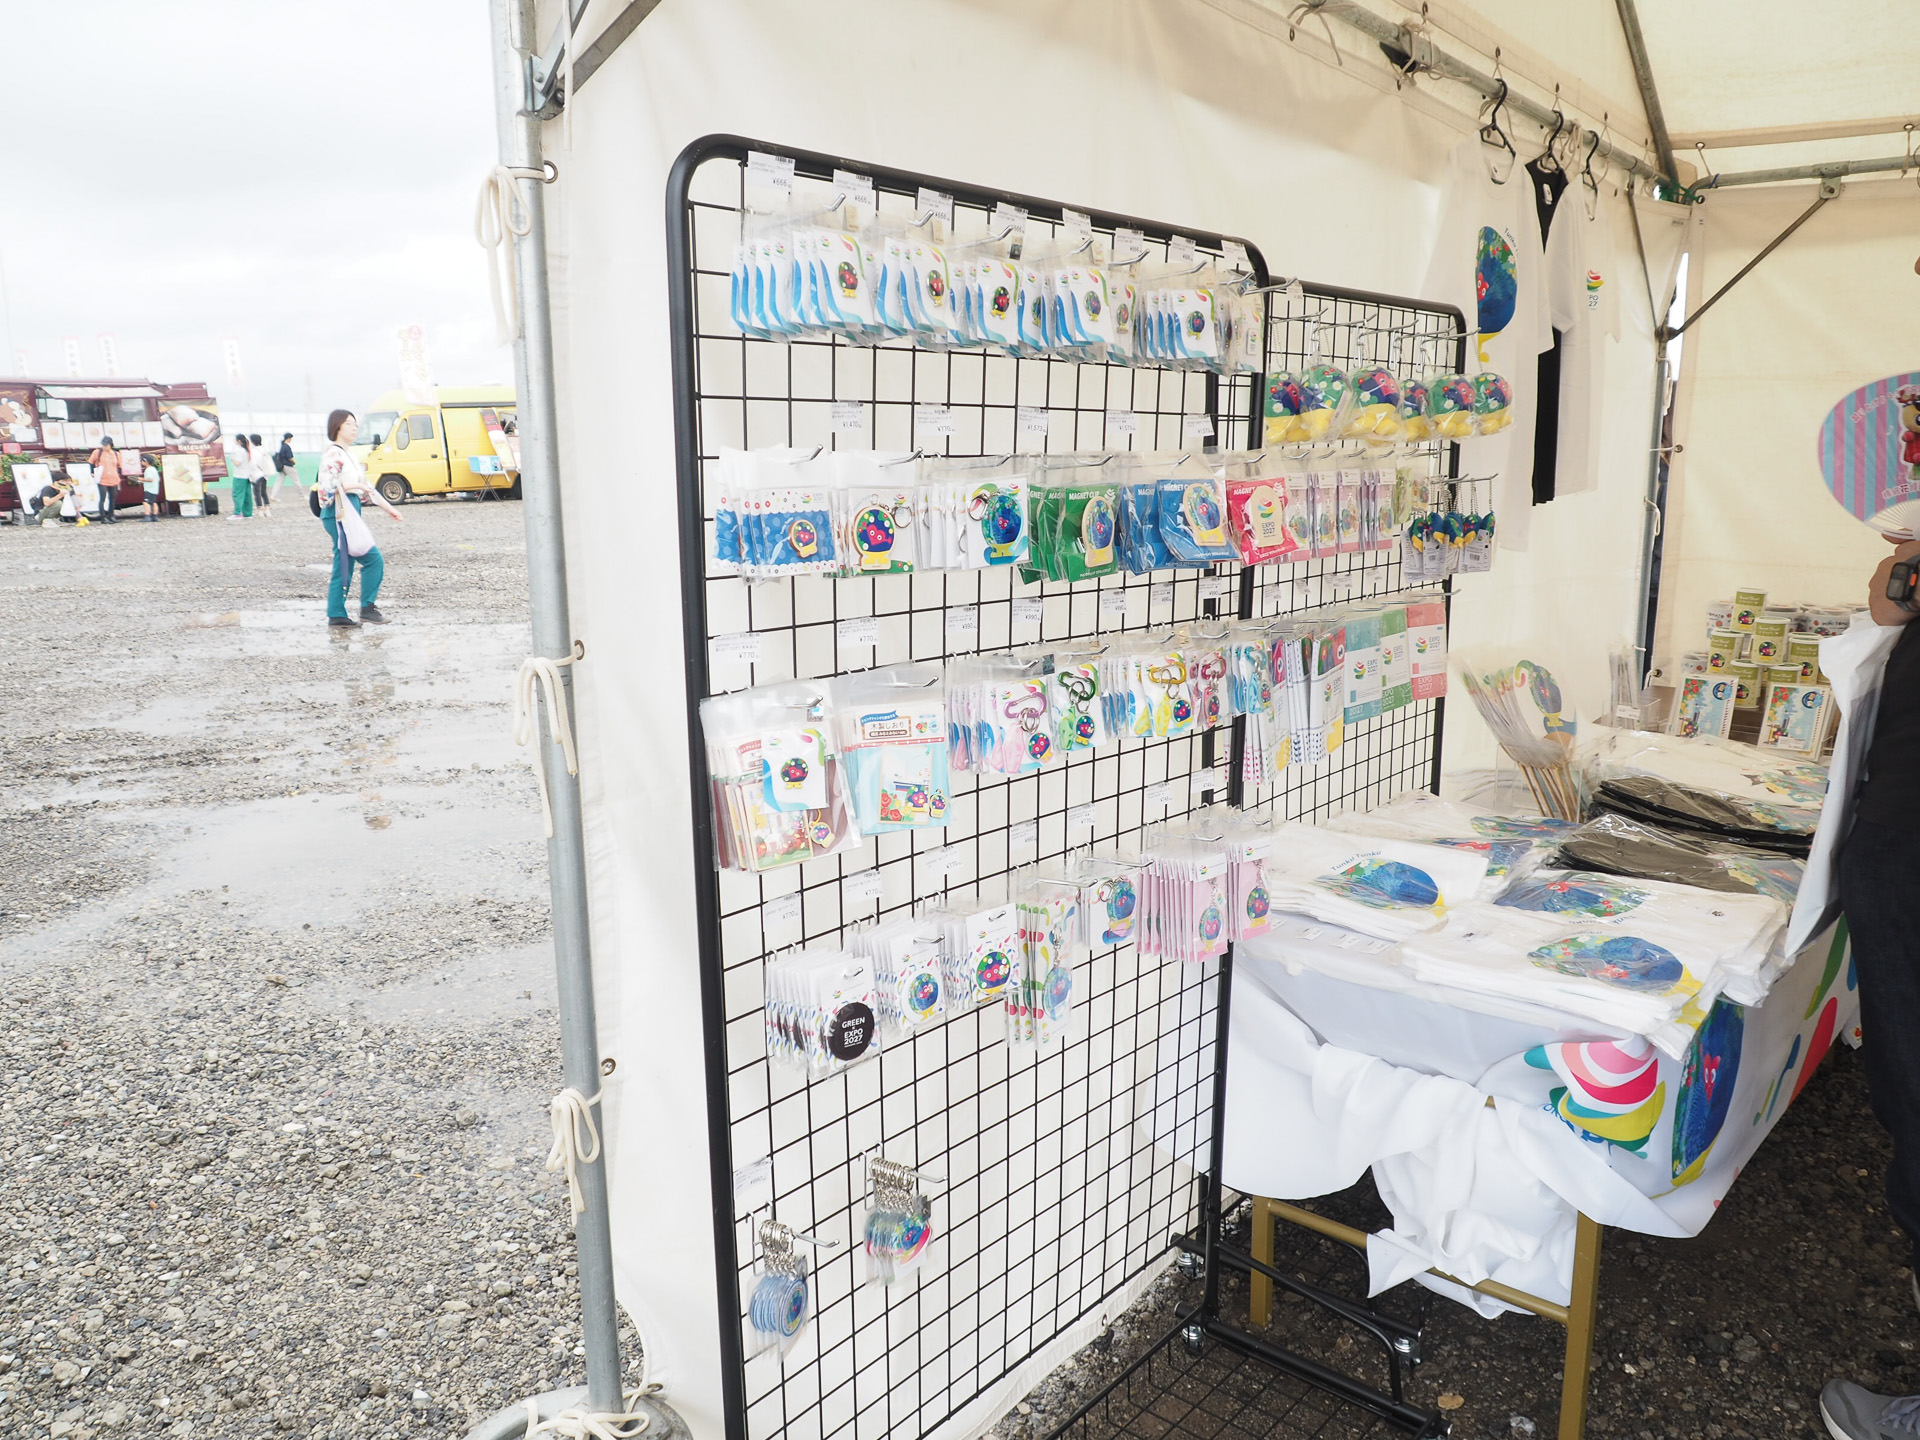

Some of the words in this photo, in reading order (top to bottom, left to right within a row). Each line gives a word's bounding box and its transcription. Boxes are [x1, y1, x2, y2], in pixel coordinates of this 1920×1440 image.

[1163, 483, 1183, 492] MAGNET
[1069, 491, 1089, 500] MAGNET
[1261, 521, 1275, 529] EXPO
[1262, 527, 1275, 535] 2027
[1393, 645, 1403, 653] EXPO
[1393, 651, 1404, 659] 2027
[1367, 658, 1378, 666] EXPO
[1367, 665, 1378, 673] 2027
[1418, 676, 1432, 685] EXPO
[1418, 683, 1432, 692] 2027
[1349, 705, 1364, 716] 2027
[871, 721, 905, 730] 木製しおり
[1331, 856, 1355, 871] Tunku
[1356, 850, 1382, 858] Tunku
[841, 1016, 866, 1029] GREEN
[844, 1028, 864, 1039] EXPO
[844, 1035, 863, 1046] 2027
